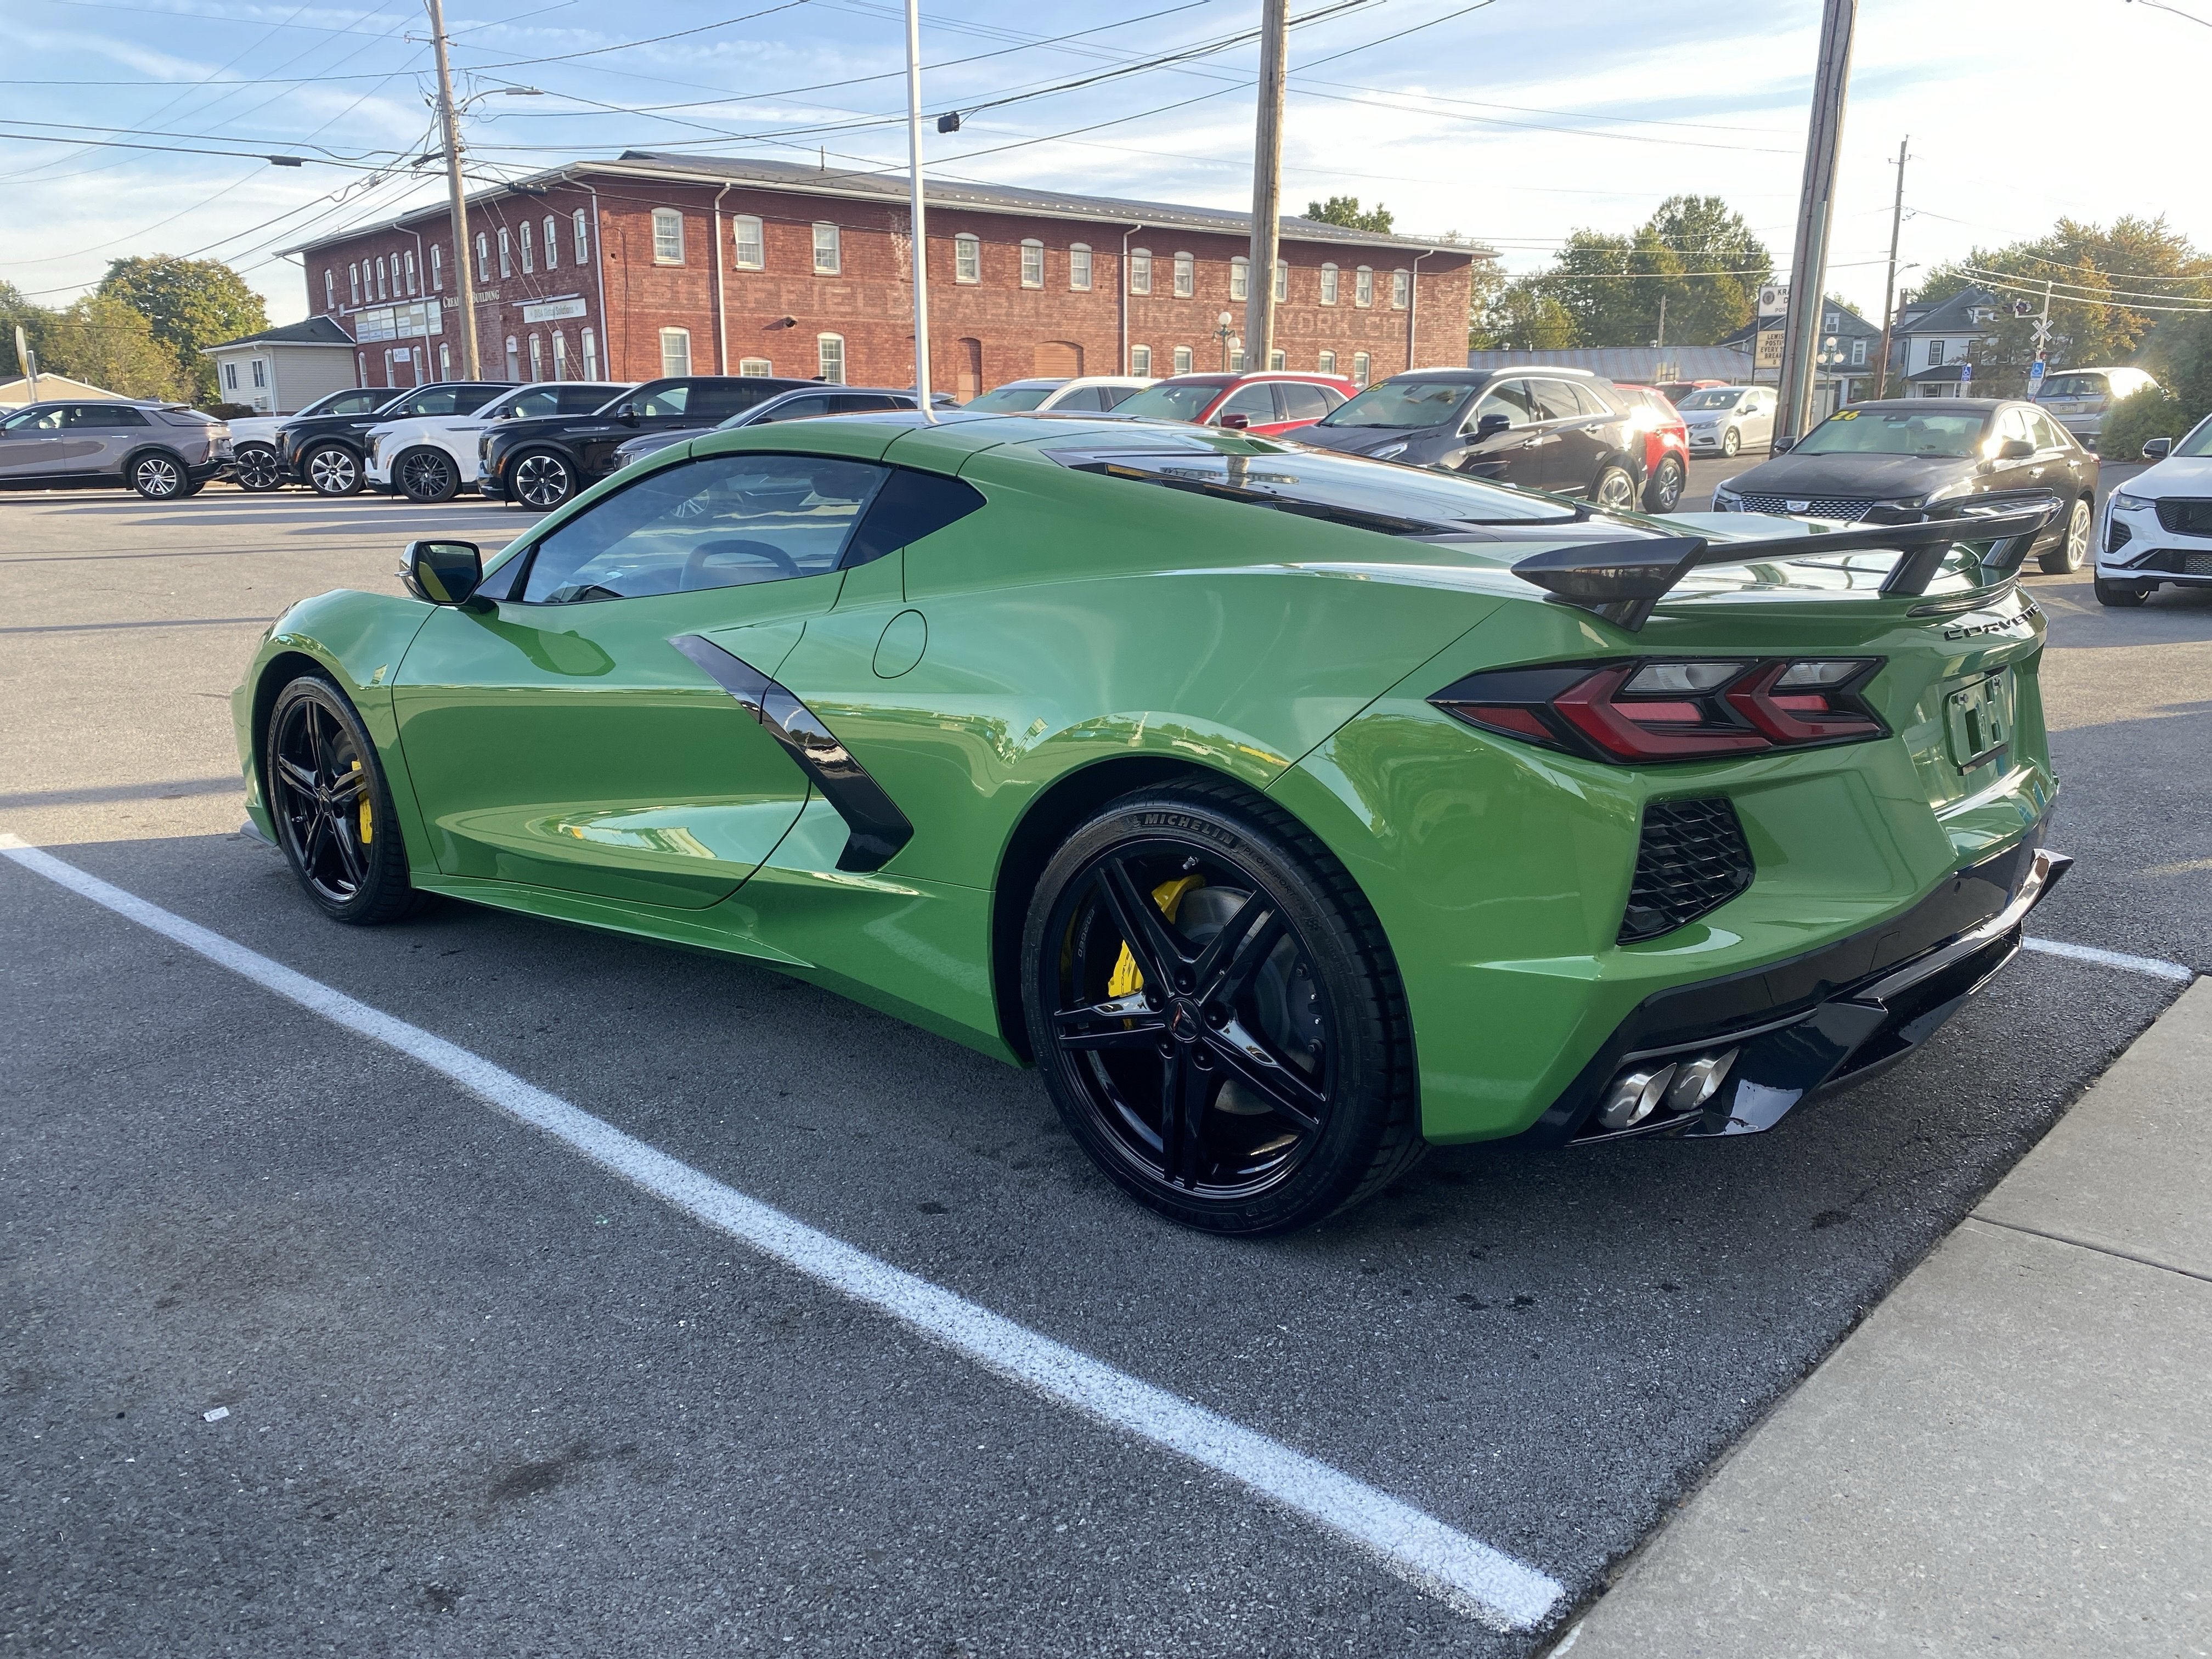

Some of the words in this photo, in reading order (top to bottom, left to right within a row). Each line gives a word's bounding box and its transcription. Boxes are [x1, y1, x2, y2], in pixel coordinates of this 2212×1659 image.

[472, 290, 500, 303] BUILDING
[555, 305, 574, 315] Solutions
[1279, 309, 1351, 335] YORK
[1830, 410, 1861, 421] 26
[1944, 603, 2040, 641] CORVETTE
[1144, 814, 1234, 844] MICHELIN
[1077, 909, 1095, 957] FORGED
[1121, 951, 1130, 994] CORVE
